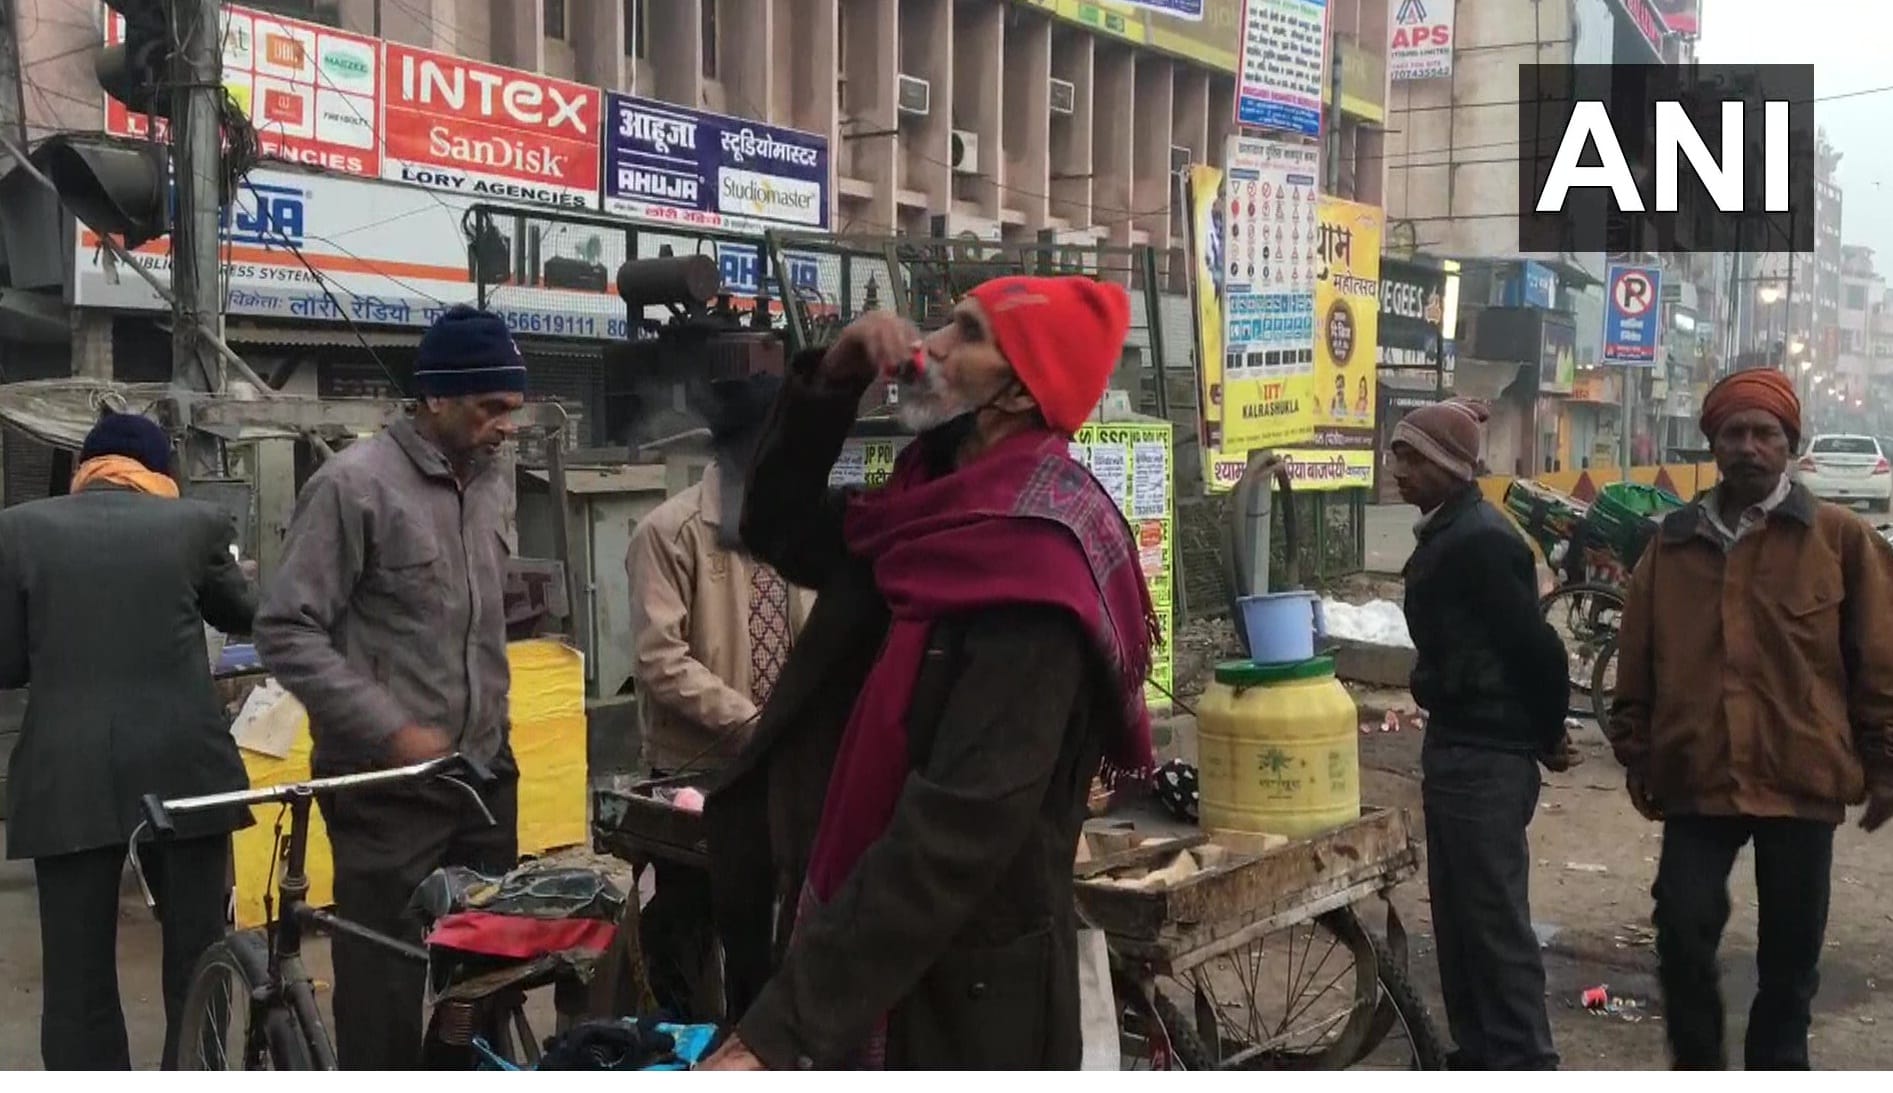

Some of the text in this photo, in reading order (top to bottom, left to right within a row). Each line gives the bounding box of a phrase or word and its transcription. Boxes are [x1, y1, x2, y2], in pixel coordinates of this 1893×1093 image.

[1391, 24, 1449, 49] APS
[619, 109, 697, 154] आहूजा
[261, 142, 363, 172] ENCIES
[429, 126, 564, 178] SanDisk
[401, 168, 586, 207] LORY AGENCIES
[618, 168, 699, 201] AHUJA
[723, 176, 812, 210] Studiomaster
[259, 267, 324, 283] SYSTEMS
